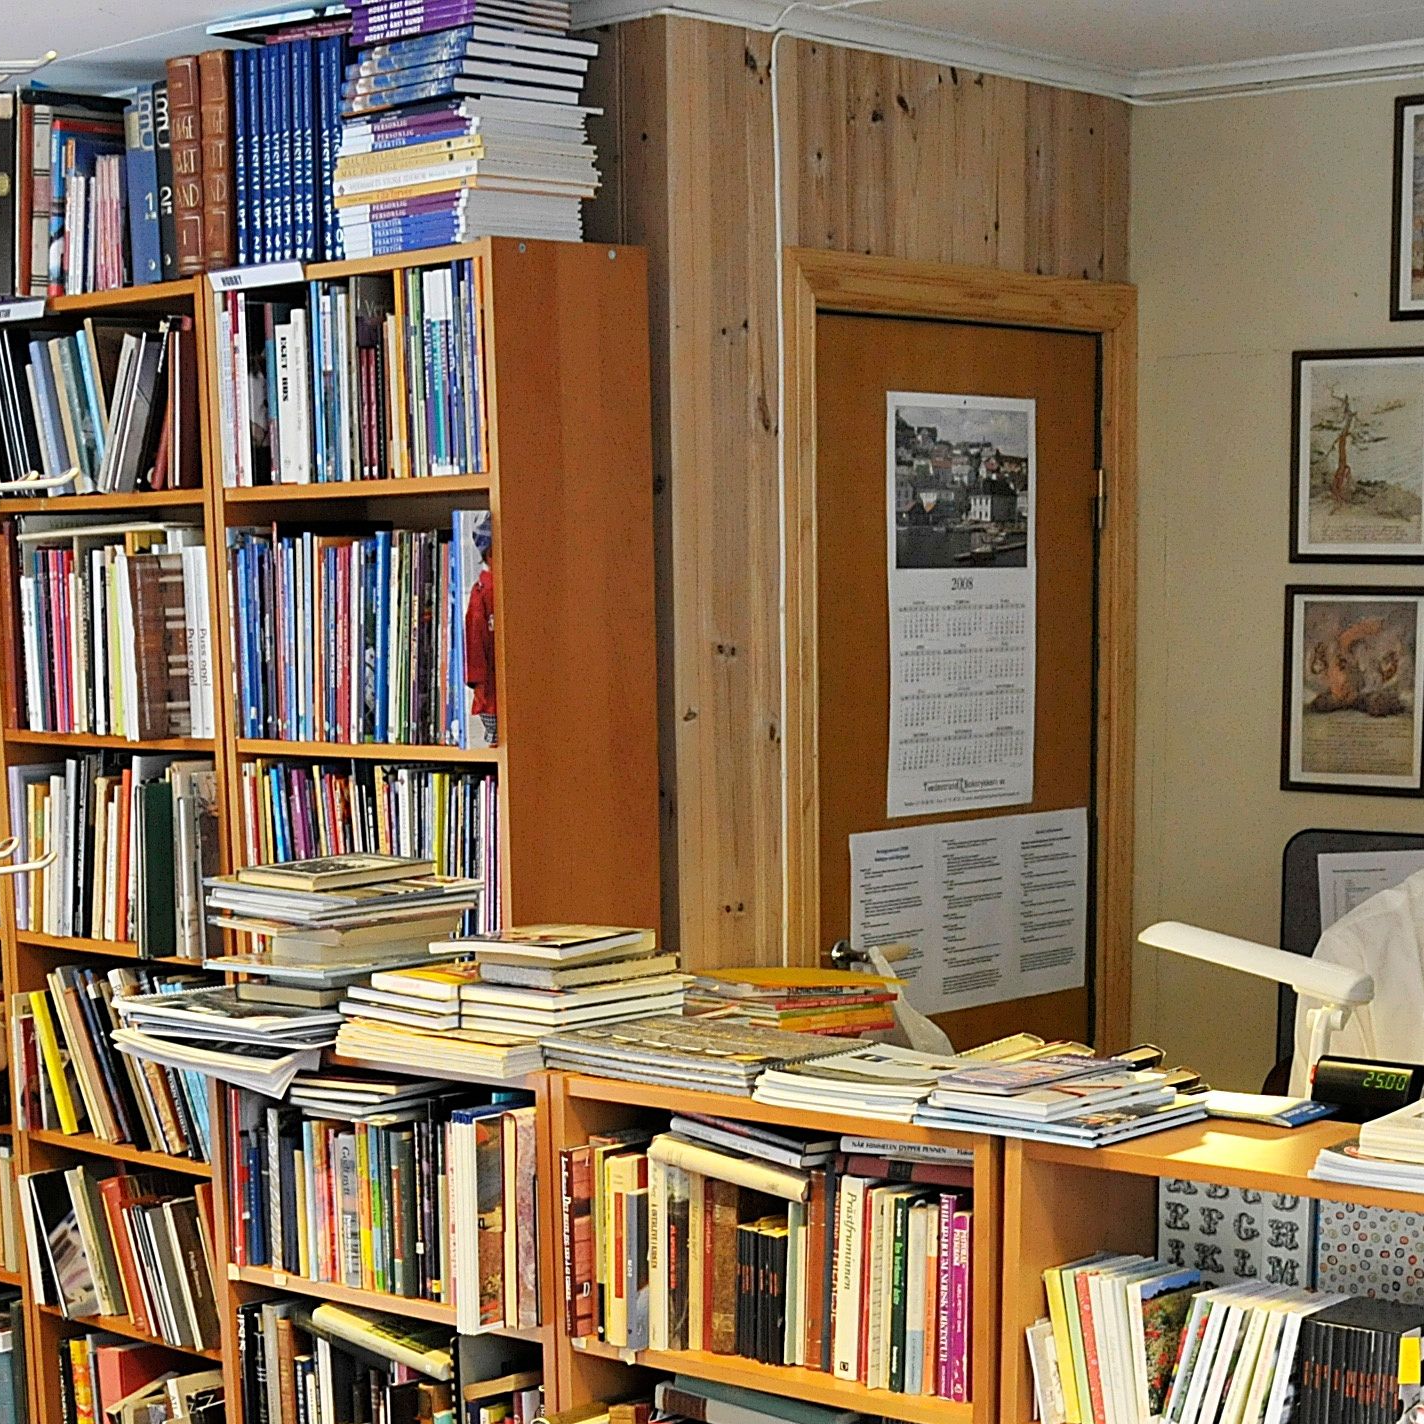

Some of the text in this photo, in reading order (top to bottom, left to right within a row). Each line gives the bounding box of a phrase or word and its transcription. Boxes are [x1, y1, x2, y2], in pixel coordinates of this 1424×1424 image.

[365, 33, 384, 42] HOBBY
[221, 275, 242, 286] HOBBY
[951, 576, 974, 592] 2008
